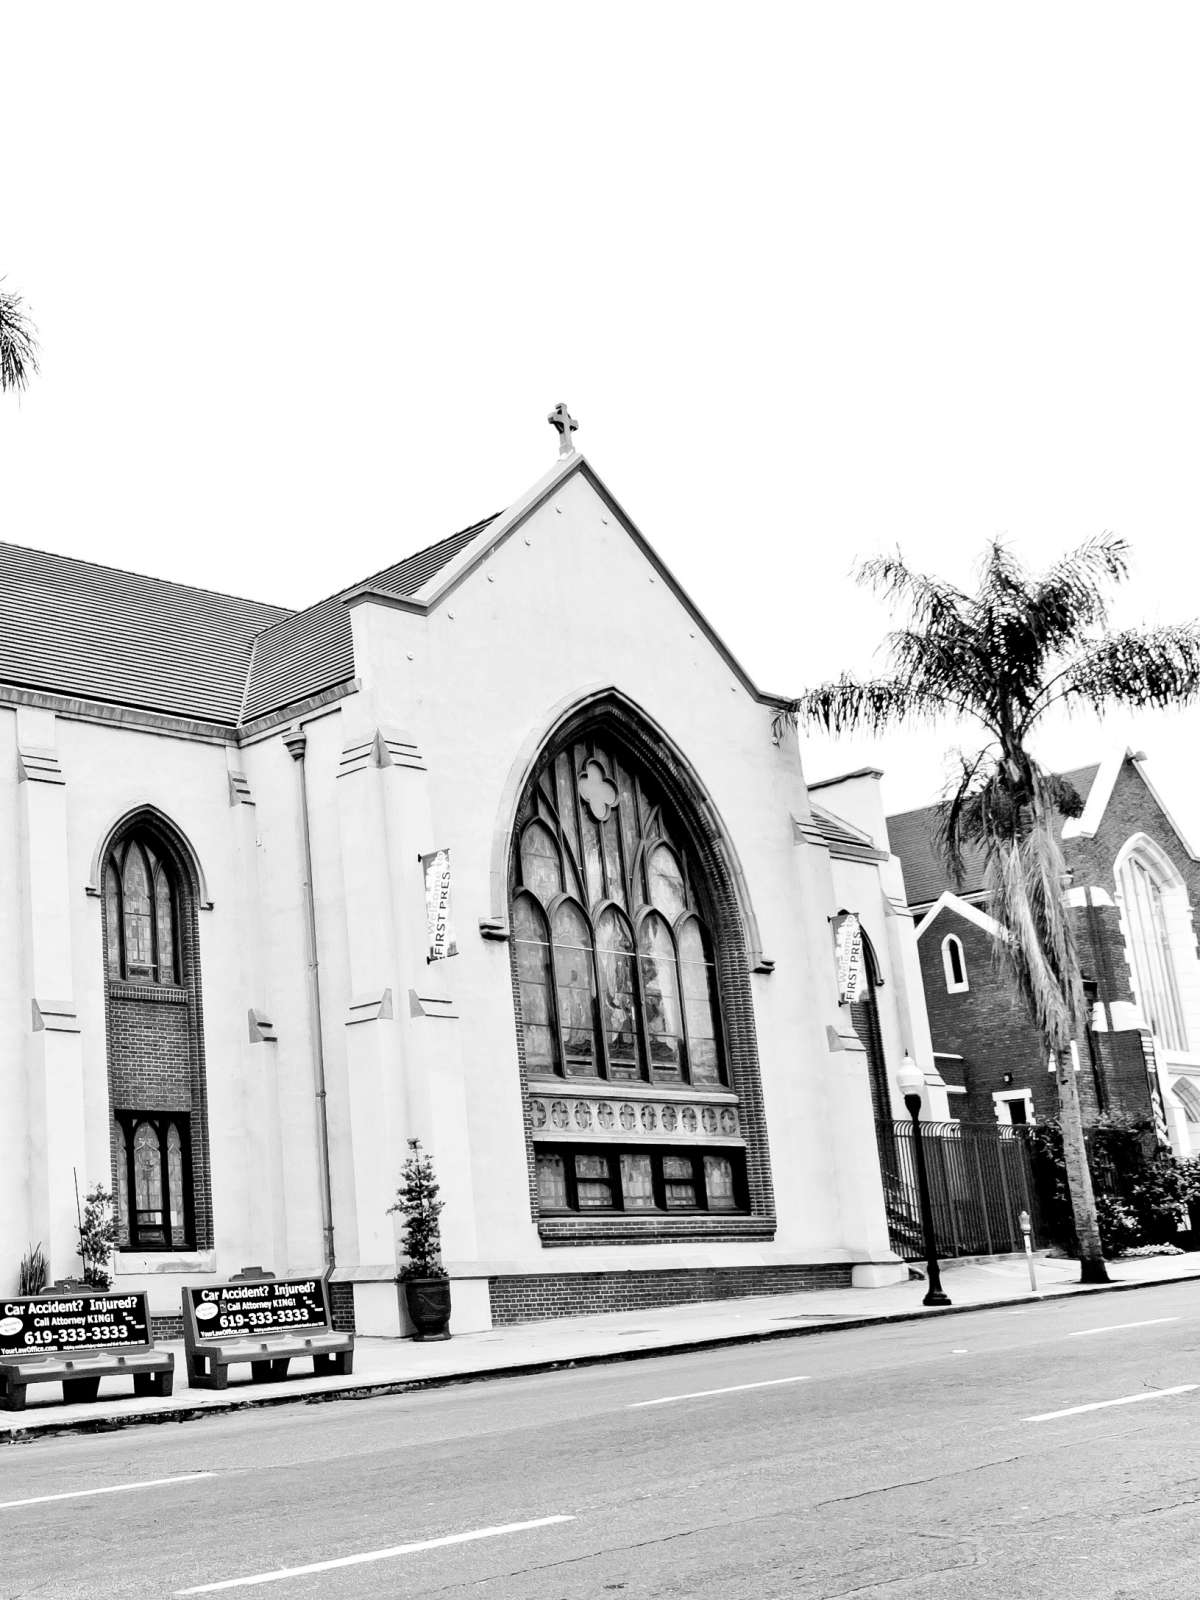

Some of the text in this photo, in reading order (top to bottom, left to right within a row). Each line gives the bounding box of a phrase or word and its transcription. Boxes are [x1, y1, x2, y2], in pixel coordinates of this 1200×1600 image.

[434, 871, 451, 956] FIRST PRES
[846, 931, 862, 1001] FIRST PRES
[201, 1282, 316, 1301] Car Accident? Injured?
[4, 1296, 138, 1316] Car Accident? Injured?
[227, 1302, 241, 1311] Call
[242, 1301, 272, 1310] Attorney
[272, 1298, 296, 1307] KING!
[34, 1317, 50, 1327] Call
[51, 1316, 86, 1326] Attorney
[87, 1313, 114, 1324] KING!
[219, 1308, 309, 1328] 619-333-3333
[24, 1325, 128, 1345] 619-333-3333
[0, 1345, 58, 1355] YourLawOffice.com
